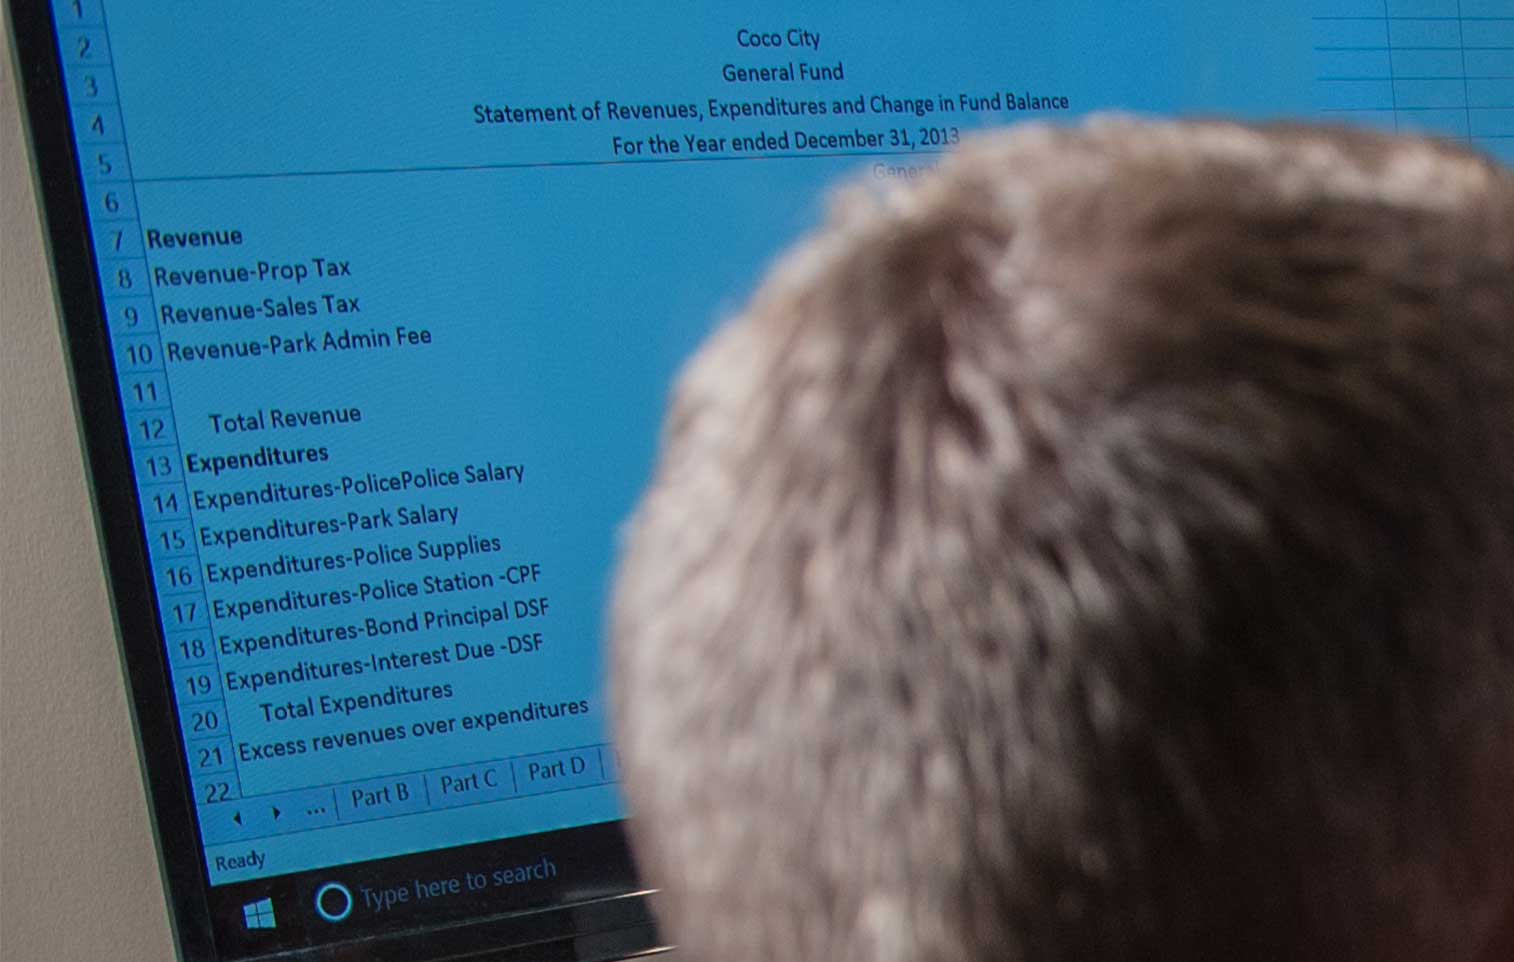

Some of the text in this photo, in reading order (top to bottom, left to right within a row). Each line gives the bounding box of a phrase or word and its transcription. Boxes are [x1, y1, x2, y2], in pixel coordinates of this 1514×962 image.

[78, 36, 91, 59] 2
[737, 28, 820, 51] Coco City
[722, 62, 844, 83] General Fund
[85, 75, 98, 98] 3
[473, 92, 1070, 124] Statement of Revenues, Expenditures and Change in Fund Balance
[90, 113, 104, 136] 4
[612, 127, 960, 155] For the Year ended December 31, 2013
[98, 153, 112, 174] 5
[104, 191, 119, 213] 6
[111, 229, 124, 251] 7
[147, 228, 243, 250] Revenue
[118, 268, 133, 290] 8
[154, 258, 351, 288] Revenue-Prop Tax
[124, 305, 139, 328] 9
[160, 294, 360, 325] Revenue-Sales Tax
[127, 342, 152, 365] 10
[167, 326, 432, 363] Revenue-Park Admin Fee
[132, 381, 158, 403] 11
[139, 417, 165, 440] 12
[210, 407, 361, 434] Total Revenue
[146, 456, 172, 477] 13
[186, 446, 329, 478] Expenditures
[193, 461, 525, 512] Expenditures-PolicePolice Salary
[153, 493, 179, 514] 14
[200, 503, 459, 548] Expenditures-Park Salary
[160, 530, 186, 551] 15
[207, 534, 501, 585] Expenditures-Police Supplies
[166, 567, 192, 587] 16
[213, 563, 541, 620] Expenditures-Police Station -CPF
[173, 602, 198, 624] 17
[219, 597, 550, 657] Expenditures-Bond Principal DSF
[180, 639, 205, 660] 18
[225, 632, 544, 693] Expenditures-Interest Due -DSF
[186, 674, 212, 697] 19
[259, 683, 453, 723] Total Expenditures
[191, 711, 218, 733] 20
[239, 699, 589, 763] Excess revenues over expenditures
[199, 747, 223, 768] 21
[528, 755, 586, 781] Part D
[203, 783, 230, 802] 22
[441, 769, 498, 794] Part C
[352, 782, 409, 809] Part B
[216, 849, 266, 872] Ready
[361, 856, 557, 910] Type here to search
